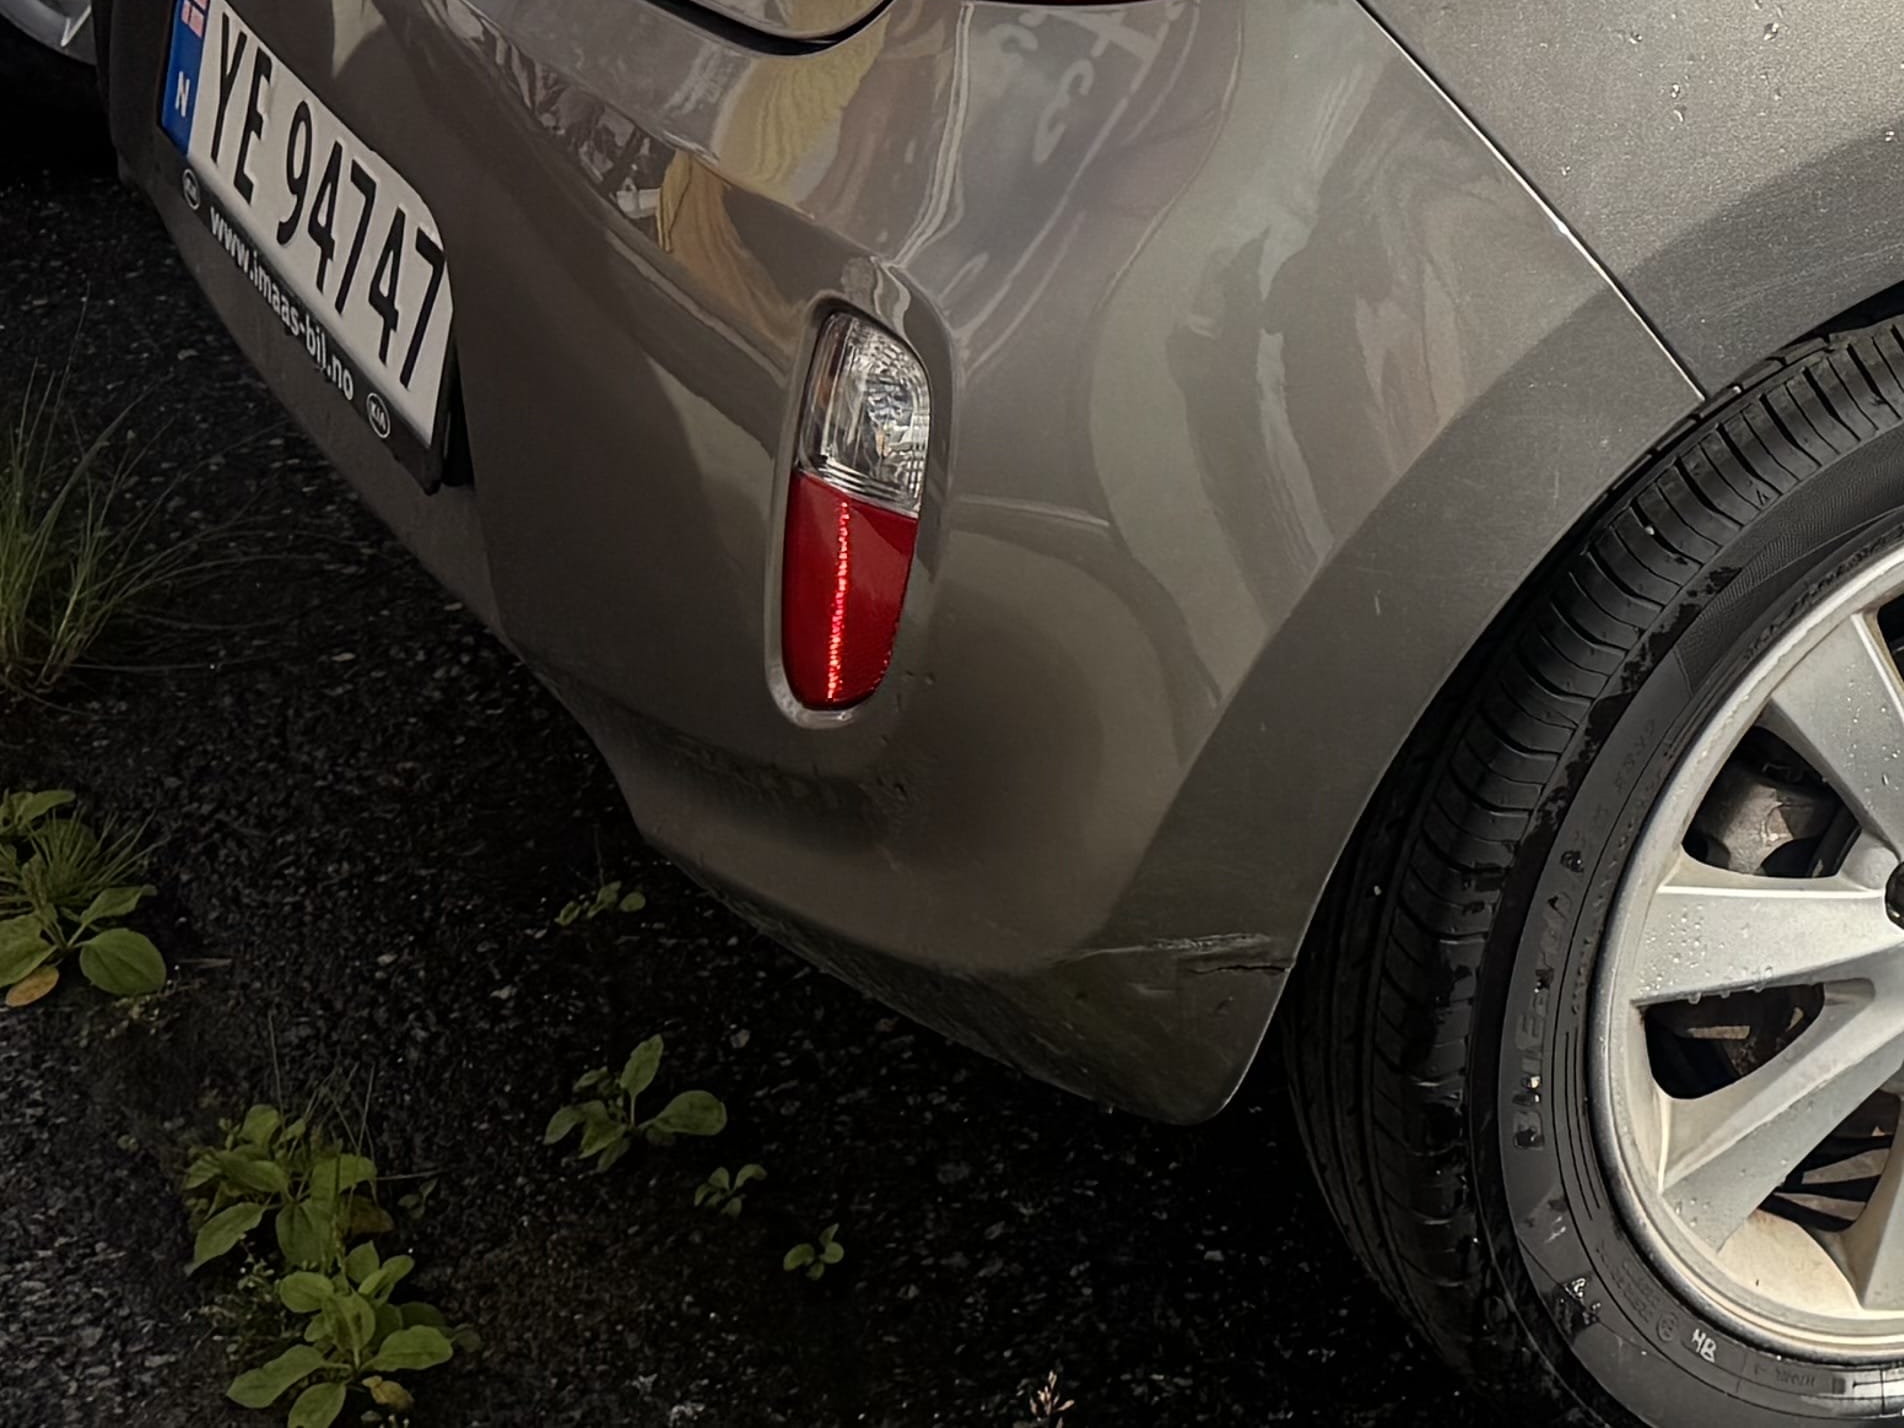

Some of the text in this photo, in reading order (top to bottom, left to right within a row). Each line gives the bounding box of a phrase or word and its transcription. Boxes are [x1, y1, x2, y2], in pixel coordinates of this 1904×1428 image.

[174, 70, 191, 118] N
[210, 11, 446, 391] YE 94747
[209, 205, 355, 402] www.imaas-bil.no
